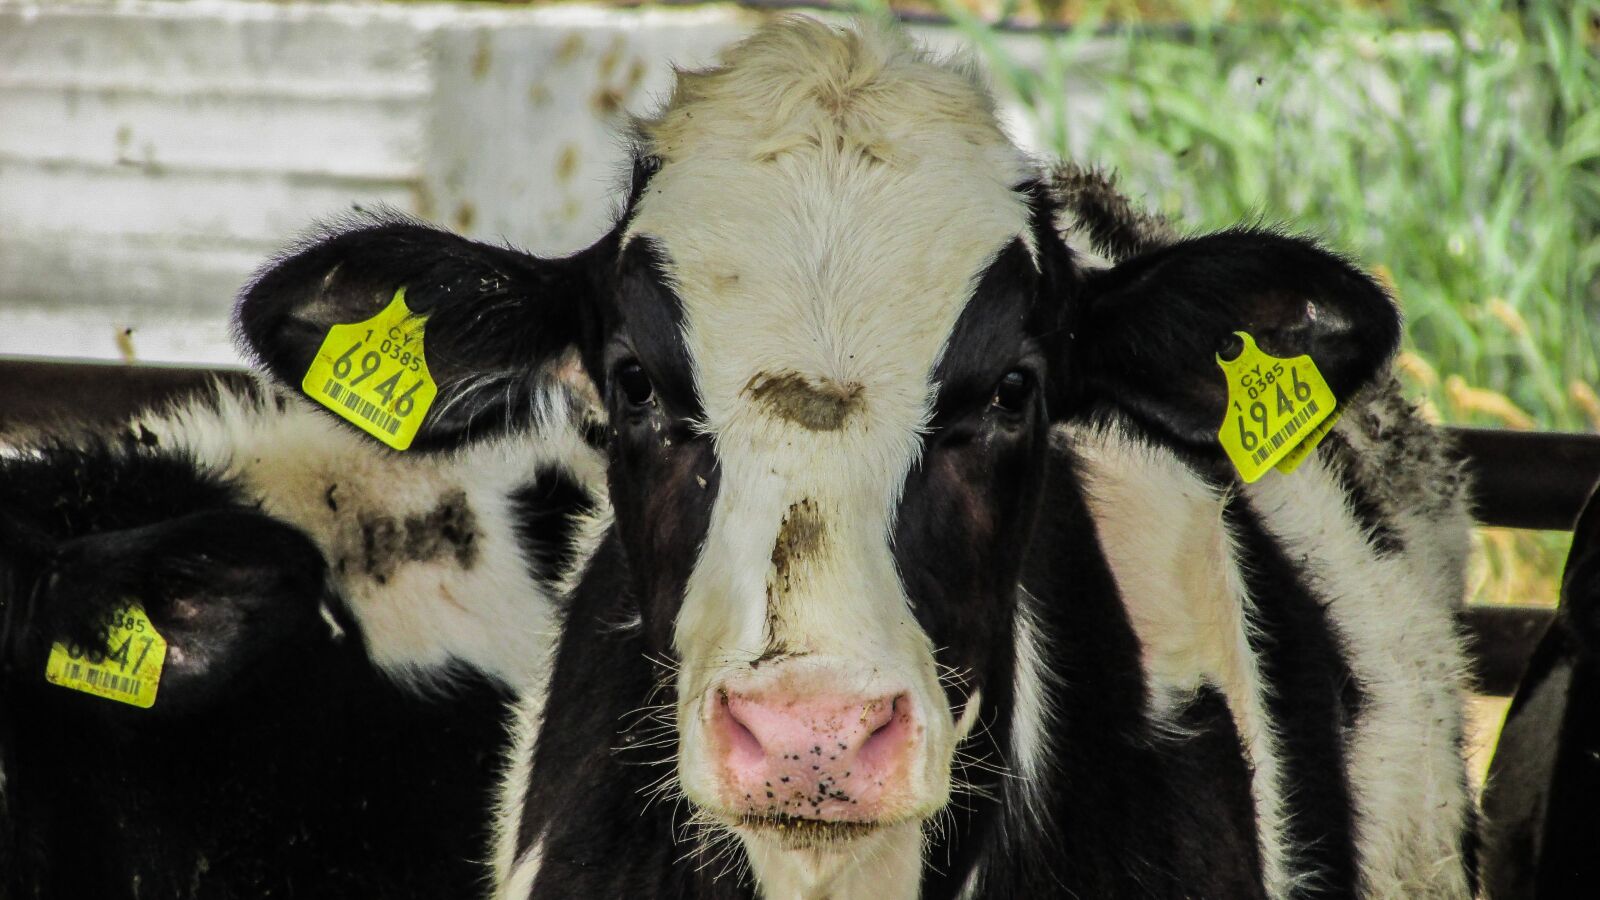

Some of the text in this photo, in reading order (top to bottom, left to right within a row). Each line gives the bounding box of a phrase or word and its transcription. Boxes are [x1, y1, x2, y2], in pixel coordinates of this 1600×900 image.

[365, 329, 423, 372] 1 0385
[388, 326, 413, 347] CY
[333, 341, 424, 418] 6946
[1233, 362, 1285, 412] 1 0385
[1240, 364, 1262, 388] CY
[1237, 366, 1312, 452] 6946
